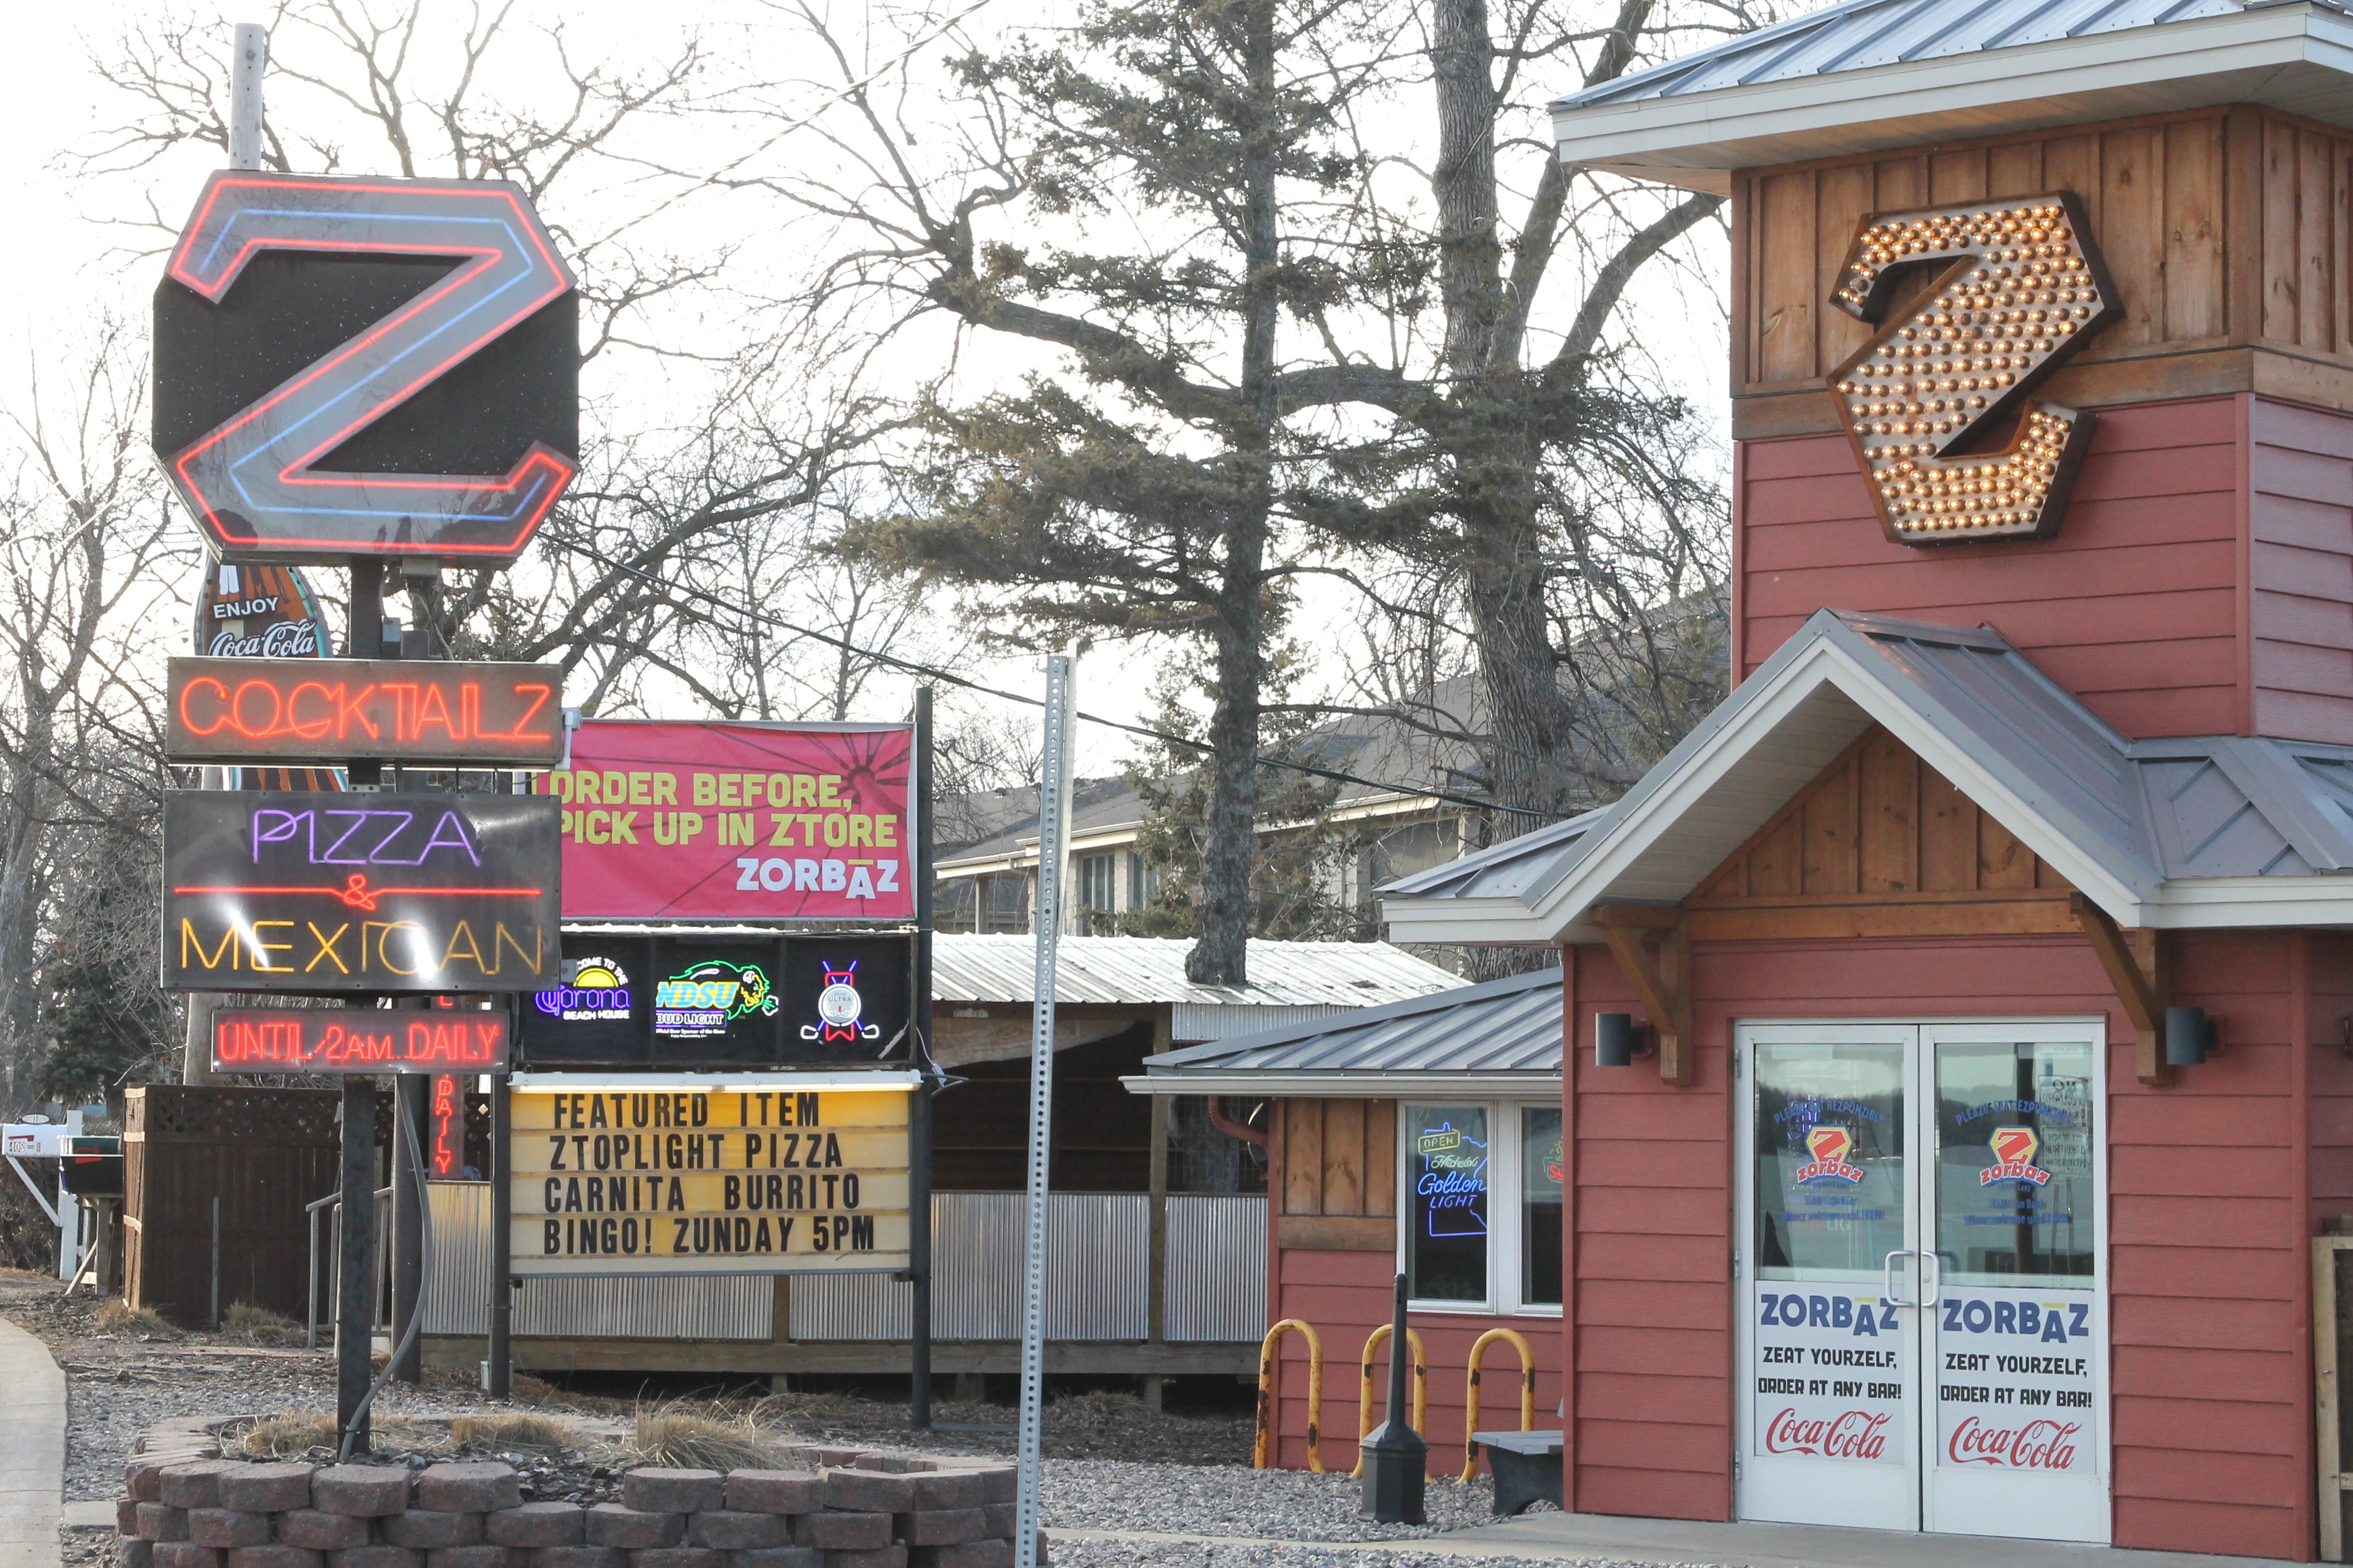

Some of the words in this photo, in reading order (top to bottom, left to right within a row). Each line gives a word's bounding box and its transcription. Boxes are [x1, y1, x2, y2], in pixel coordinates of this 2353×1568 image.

[163, 170, 580, 555] Z
[1826, 189, 2124, 547] Z
[213, 597, 279, 619] ENJOY
[208, 618, 318, 657] Coca-Cola
[550, 770, 677, 806] ORDER
[694, 774, 852, 813] BEFORE,
[252, 809, 481, 868] PIZZA
[654, 811, 703, 845] UP
[718, 813, 754, 846] IN
[769, 814, 898, 848] ZTORE
[342, 874, 377, 911] &
[181, 917, 543, 975] MEXICAN
[604, 958, 616, 970] TO
[614, 966, 628, 985] THE
[535, 983, 630, 1016] Corona
[656, 981, 740, 1009] NDSU
[563, 1011, 597, 1020] BEACH
[598, 1010, 629, 1020] HOUSE
[656, 1013, 683, 1025] BUD
[684, 1013, 724, 1025] LIGHT
[218, 1023, 313, 1060] UNTIL
[326, 1026, 393, 1060] 2AM
[408, 1023, 499, 1060] DAILY
[436, 1080, 454, 1173] DAILY
[554, 1093, 708, 1128] FEATURED
[740, 1092, 819, 1127] ITEM
[549, 1134, 725, 1170] ZTOPLIGHT
[746, 1132, 843, 1169] PIZZA
[1424, 1135, 1454, 1148] OPEN
[1811, 1129, 1848, 1163] Z
[1995, 1130, 2034, 1164] Z
[1417, 1170, 1487, 1195] Golden
[1796, 1159, 1863, 1184] zorbaz
[1980, 1161, 2051, 1186] zorbaz
[545, 1176, 685, 1213] CARNITA
[724, 1173, 859, 1210] BURRITO
[1430, 1195, 1478, 1209] LIGHT
[544, 1218, 652, 1255] BINGO!
[674, 1216, 794, 1253] ZUNDAY
[813, 1214, 874, 1252] 5PM
[1763, 1347, 1805, 1365] ZEAT
[1811, 1348, 1897, 1370] YOURZELF,
[1945, 1353, 1990, 1371] ZEAT
[1997, 1355, 2088, 1378] YOURZELF,
[1758, 1378, 1804, 1395] ORDER
[1810, 1379, 1828, 1396] AT
[1834, 1381, 1863, 1398] ANY
[1868, 1383, 1902, 1400] BAR!
[1941, 1385, 1990, 1403] ORDER
[1995, 1387, 2014, 1404] AT
[2021, 1389, 2051, 1406] ANY
[2057, 1391, 2092, 1408] BAR!
[1765, 1408, 1893, 1460] Coca-Cola
[1949, 1416, 2084, 1470] Coca-Cola
